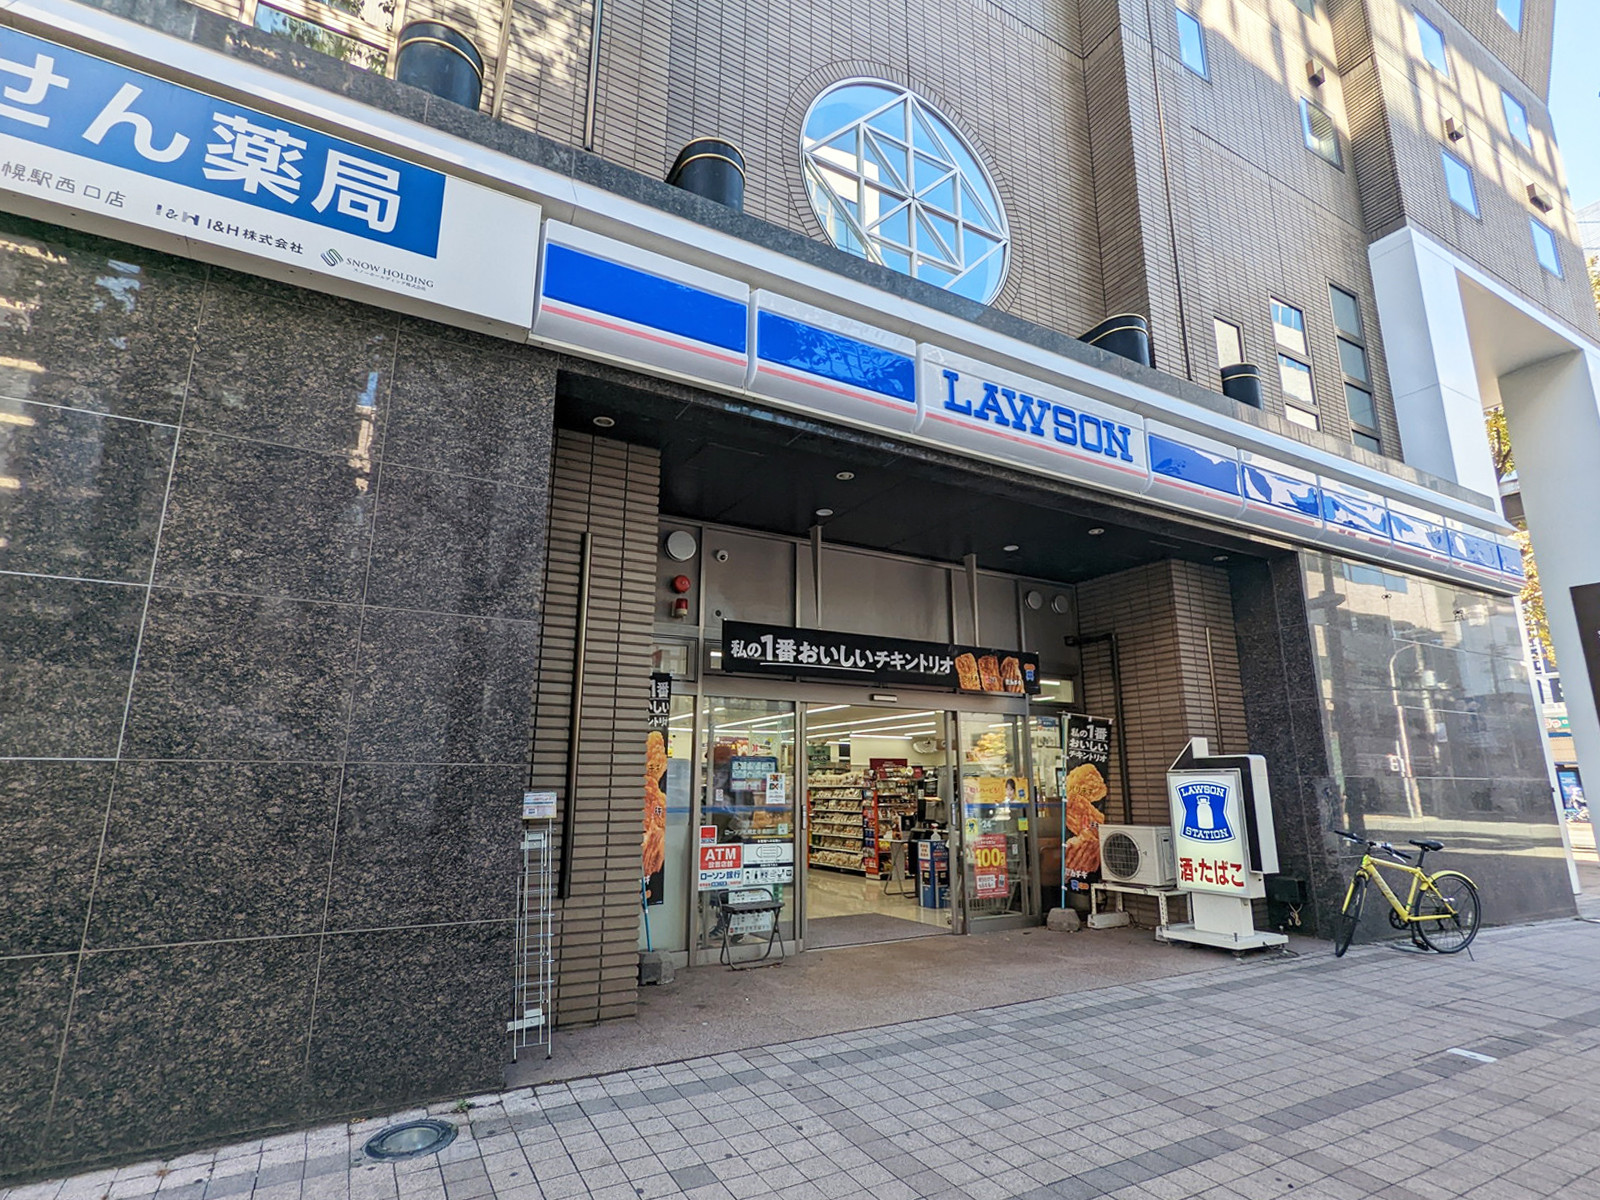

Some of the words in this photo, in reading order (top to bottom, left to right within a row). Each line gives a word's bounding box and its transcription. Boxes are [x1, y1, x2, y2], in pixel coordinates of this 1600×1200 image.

[1, 161, 126, 208] 幌駅西口店
[346, 257, 381, 273] SNOW
[383, 267, 434, 288] HOLDING
[943, 369, 1134, 463] LAWSON
[731, 634, 954, 675] 私の1番おいしいチキントリオ
[1071, 725, 1107, 740] 私の1番
[1069, 738, 1108, 751] おいしい
[1069, 751, 1107, 763] チキントリオ
[1181, 785, 1225, 797] LAWSON
[1185, 826, 1229, 839] STATION
[705, 848, 736, 861] ATM
[700, 870, 741, 880] ローソン銀行
